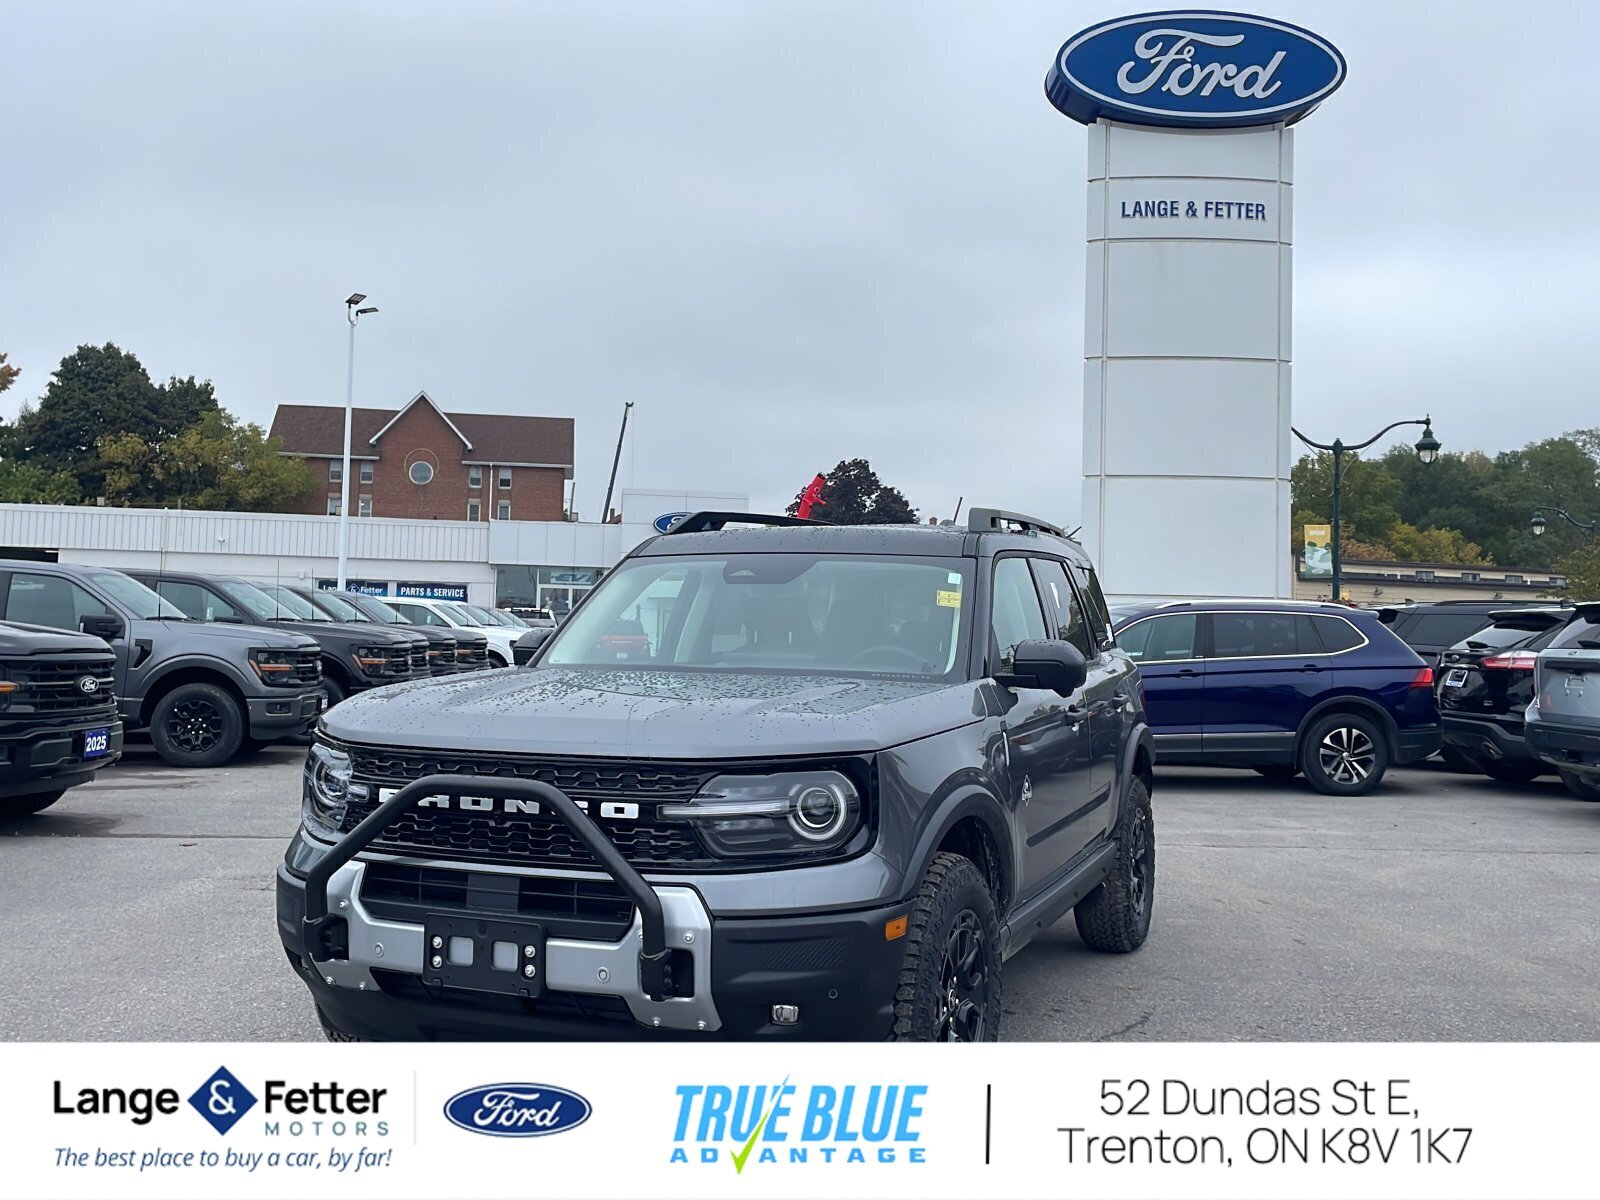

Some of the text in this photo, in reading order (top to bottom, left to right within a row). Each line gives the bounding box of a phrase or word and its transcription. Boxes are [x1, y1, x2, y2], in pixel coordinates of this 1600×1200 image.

[1116, 28, 1287, 99] Ford
[1121, 200, 1266, 221] LANGE & FETTER
[400, 587, 465, 598] PARTS & SERVICE
[85, 735, 107, 752] 2025
